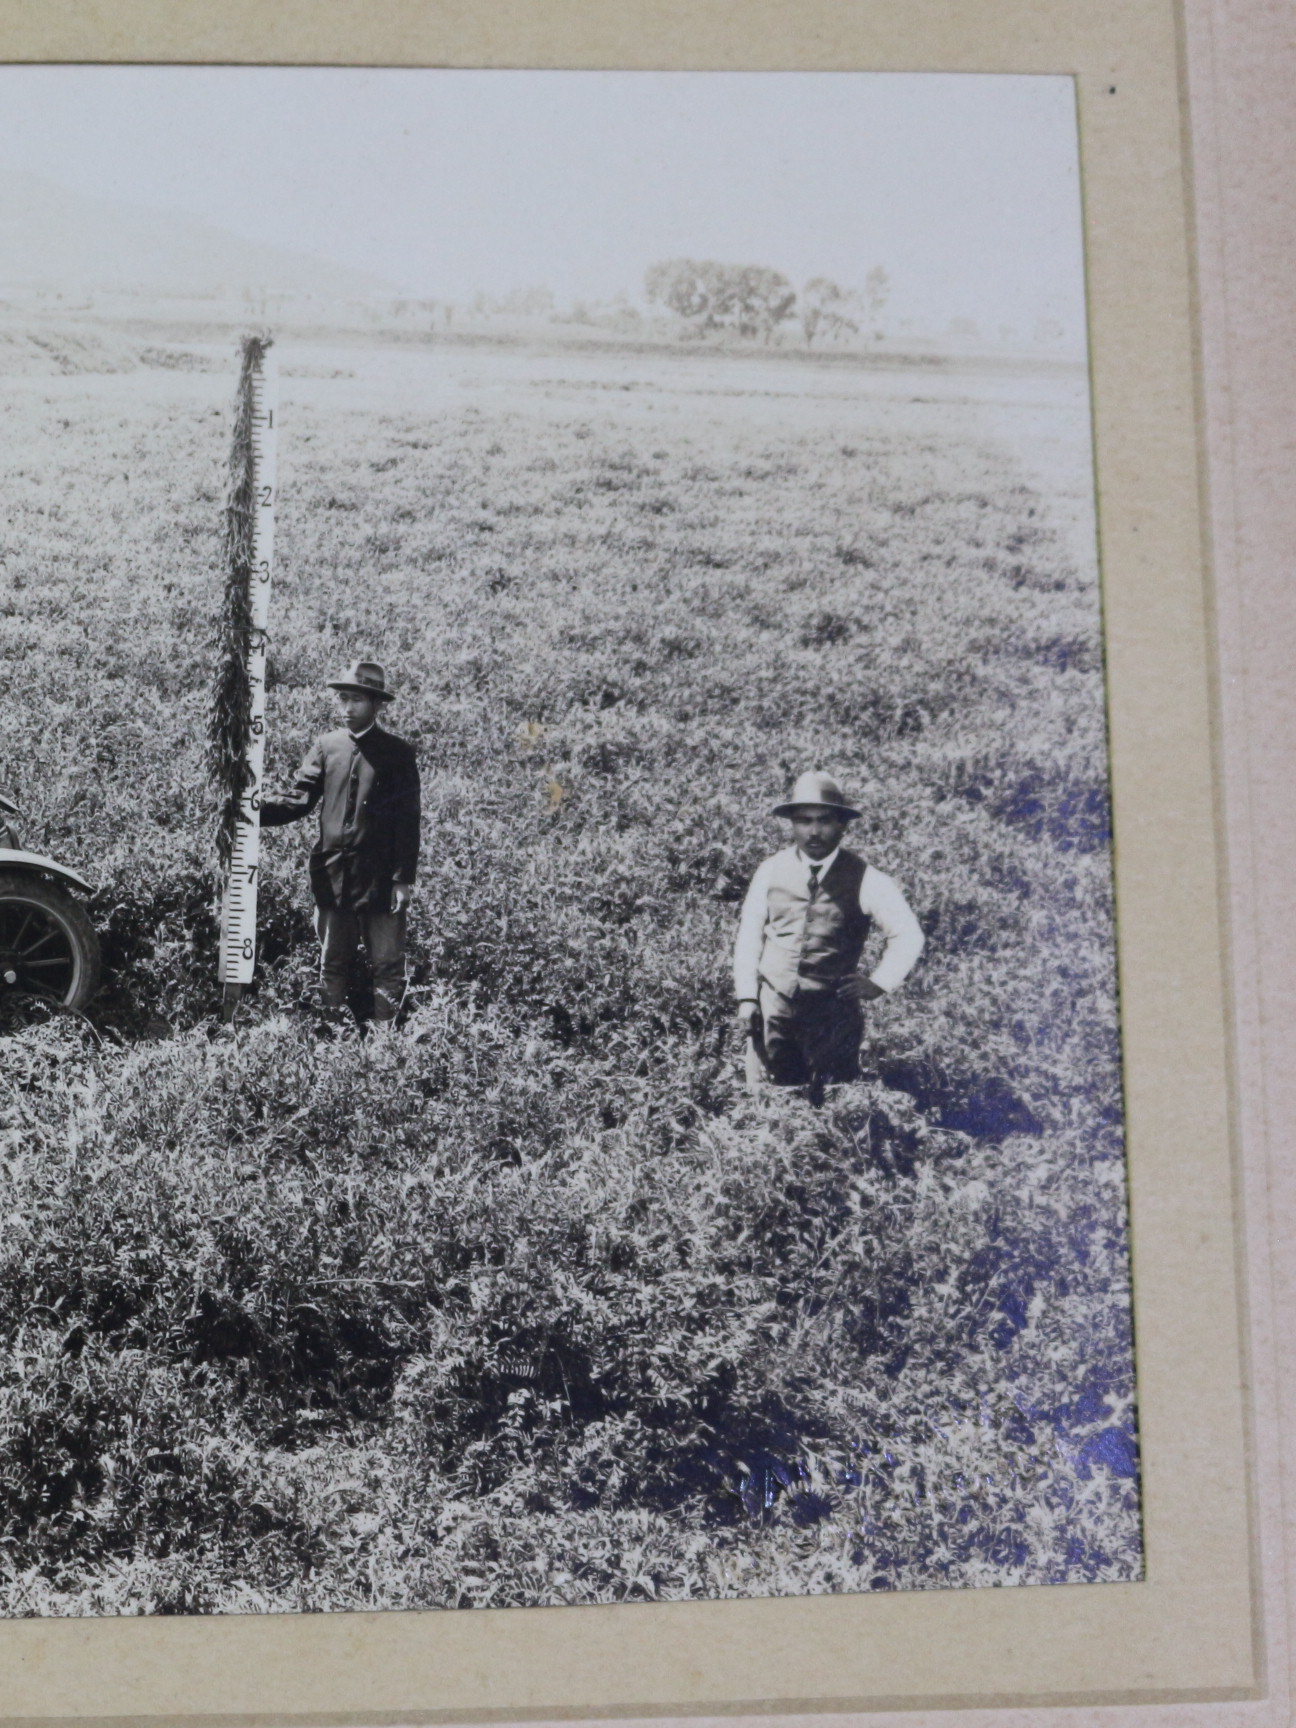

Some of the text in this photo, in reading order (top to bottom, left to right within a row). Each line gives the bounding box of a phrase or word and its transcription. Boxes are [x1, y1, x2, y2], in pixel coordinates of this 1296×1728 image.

[267, 409, 273, 428] 1
[261, 486, 272, 507] 2
[259, 560, 270, 583] 3
[251, 715, 264, 736] 5
[251, 789, 260, 811] 6
[247, 865, 258, 884] 7
[242, 938, 254, 960] 8
